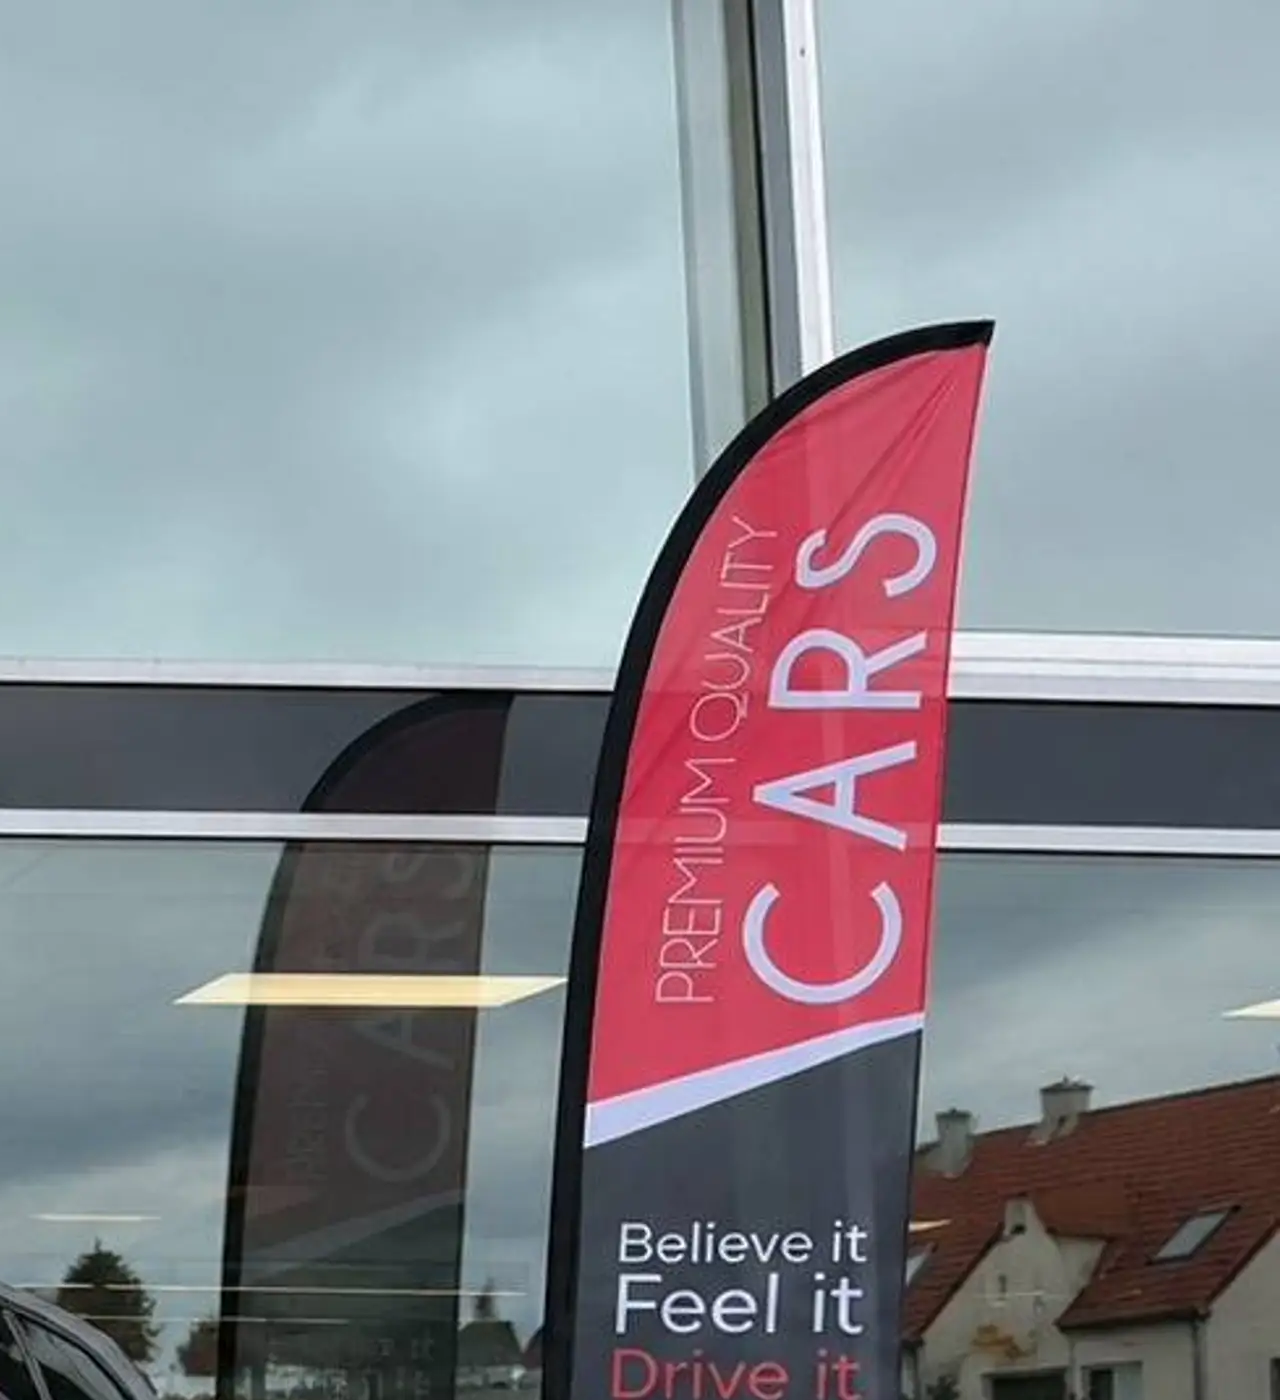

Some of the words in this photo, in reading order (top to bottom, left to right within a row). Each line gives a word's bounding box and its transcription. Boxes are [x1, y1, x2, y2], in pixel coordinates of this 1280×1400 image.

[690, 515, 779, 743] QUALITY
[743, 511, 938, 1005] CARS
[656, 758, 735, 1004] PREMIUM
[615, 1271, 780, 1334] Feel
[812, 1272, 864, 1335] it
[618, 1221, 814, 1263] Believe
[832, 1220, 868, 1262] it
[611, 1347, 789, 1400] Drive
